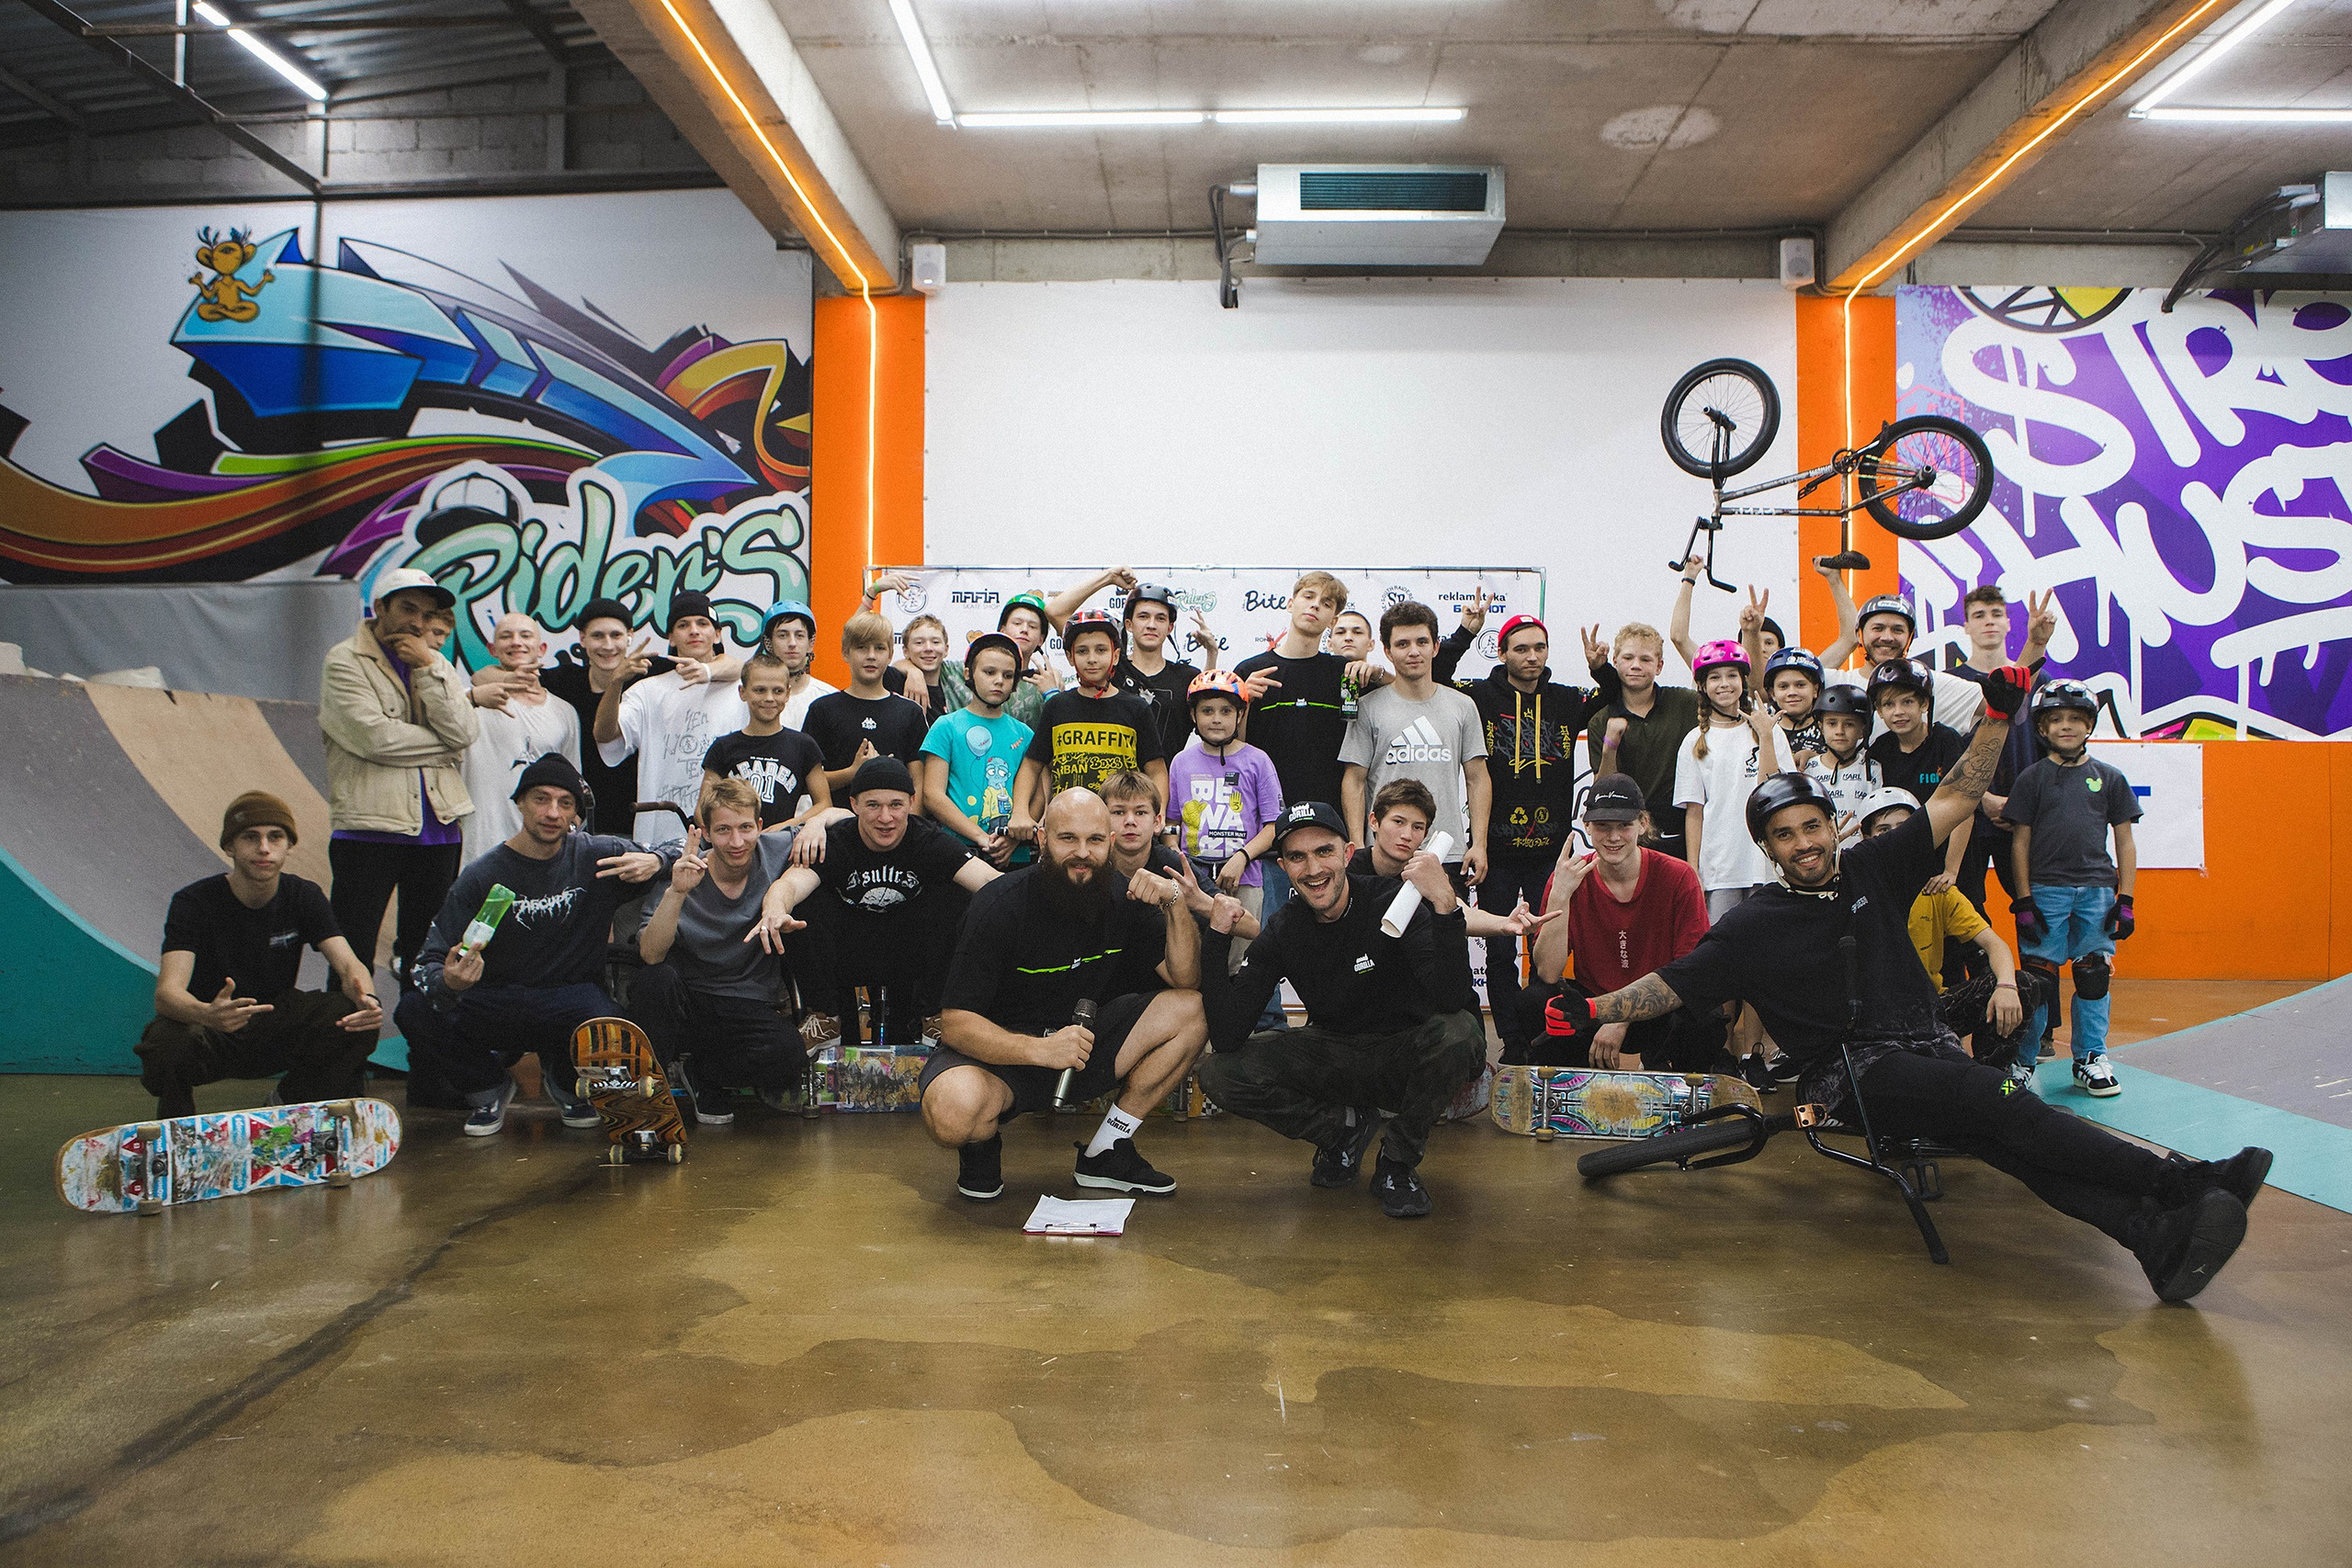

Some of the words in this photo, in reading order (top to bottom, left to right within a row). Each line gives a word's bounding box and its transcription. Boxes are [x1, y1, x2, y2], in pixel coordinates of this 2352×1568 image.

[1438, 591, 1506, 602] reklamtka
[1385, 744, 1453, 765] adidas
[1289, 807, 1316, 822] GORILLA
